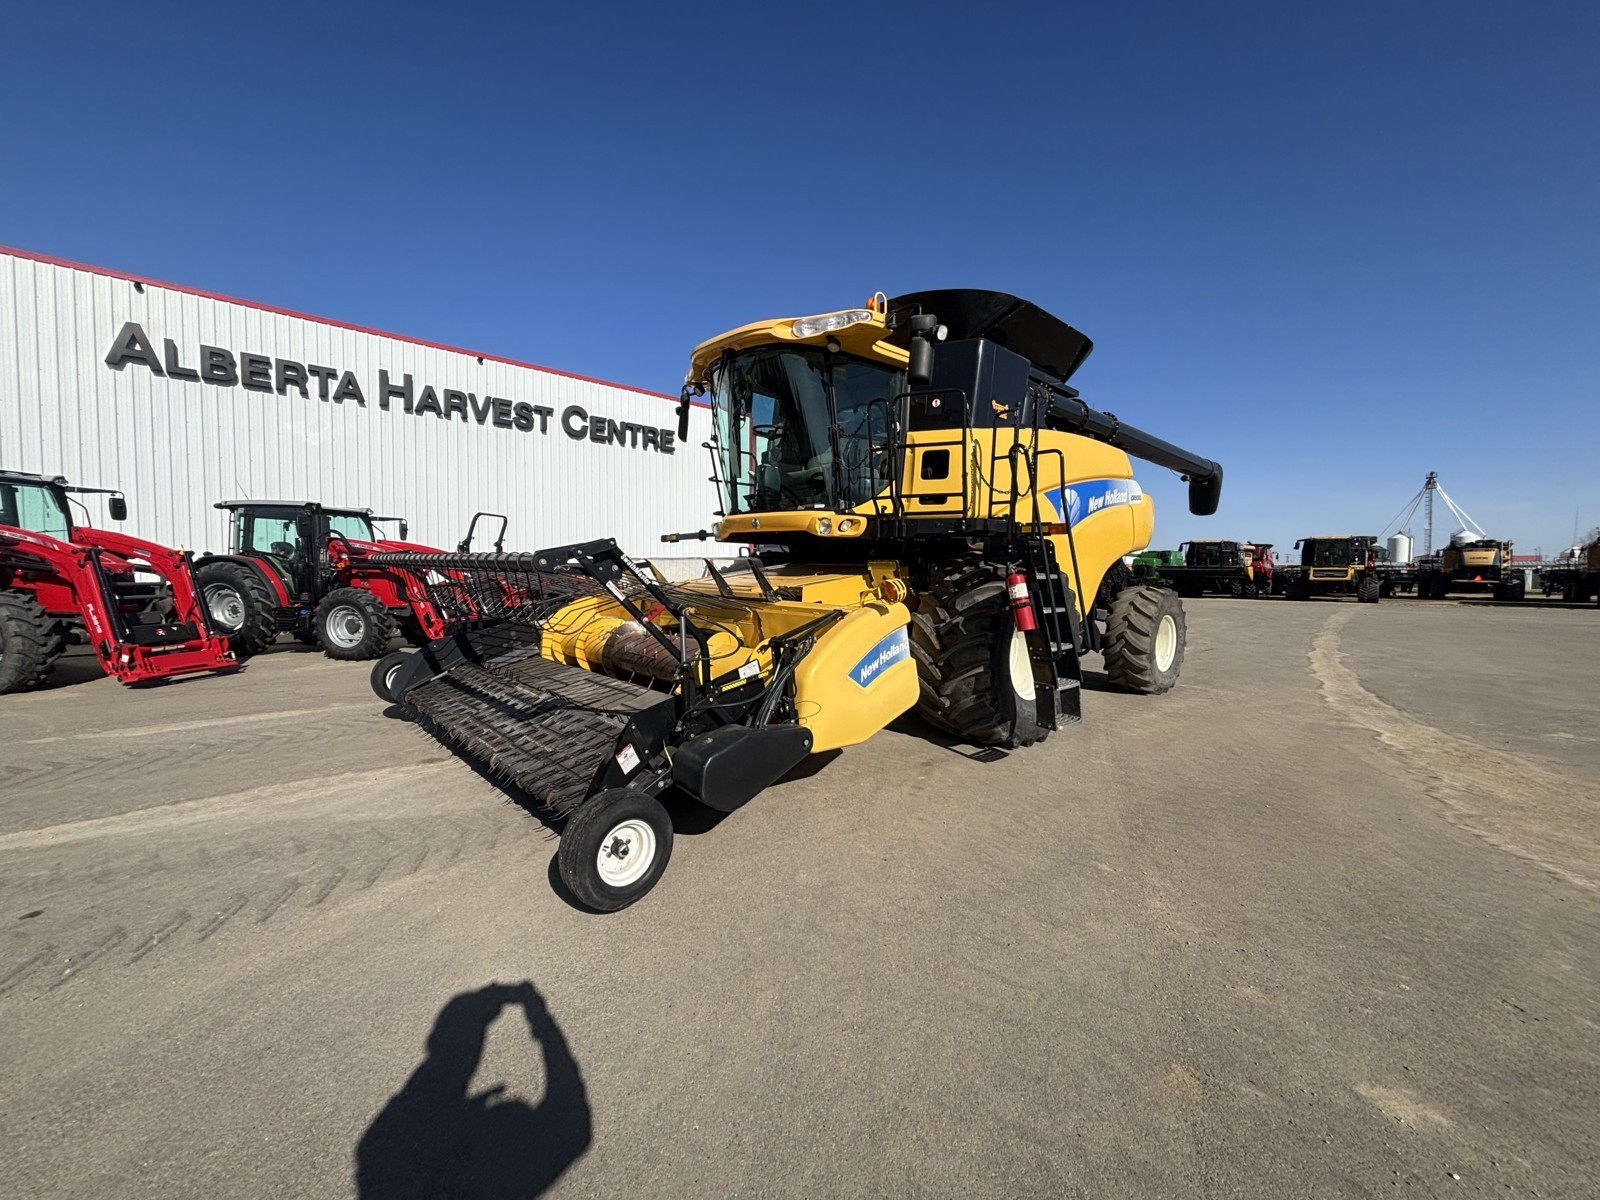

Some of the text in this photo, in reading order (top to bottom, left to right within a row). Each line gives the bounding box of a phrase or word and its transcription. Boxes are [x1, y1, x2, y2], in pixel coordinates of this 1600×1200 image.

[105, 322, 675, 454] ALBERTA HARVEST CENTRE
[1088, 488, 1127, 513] New Holland
[860, 657, 880, 683] New
